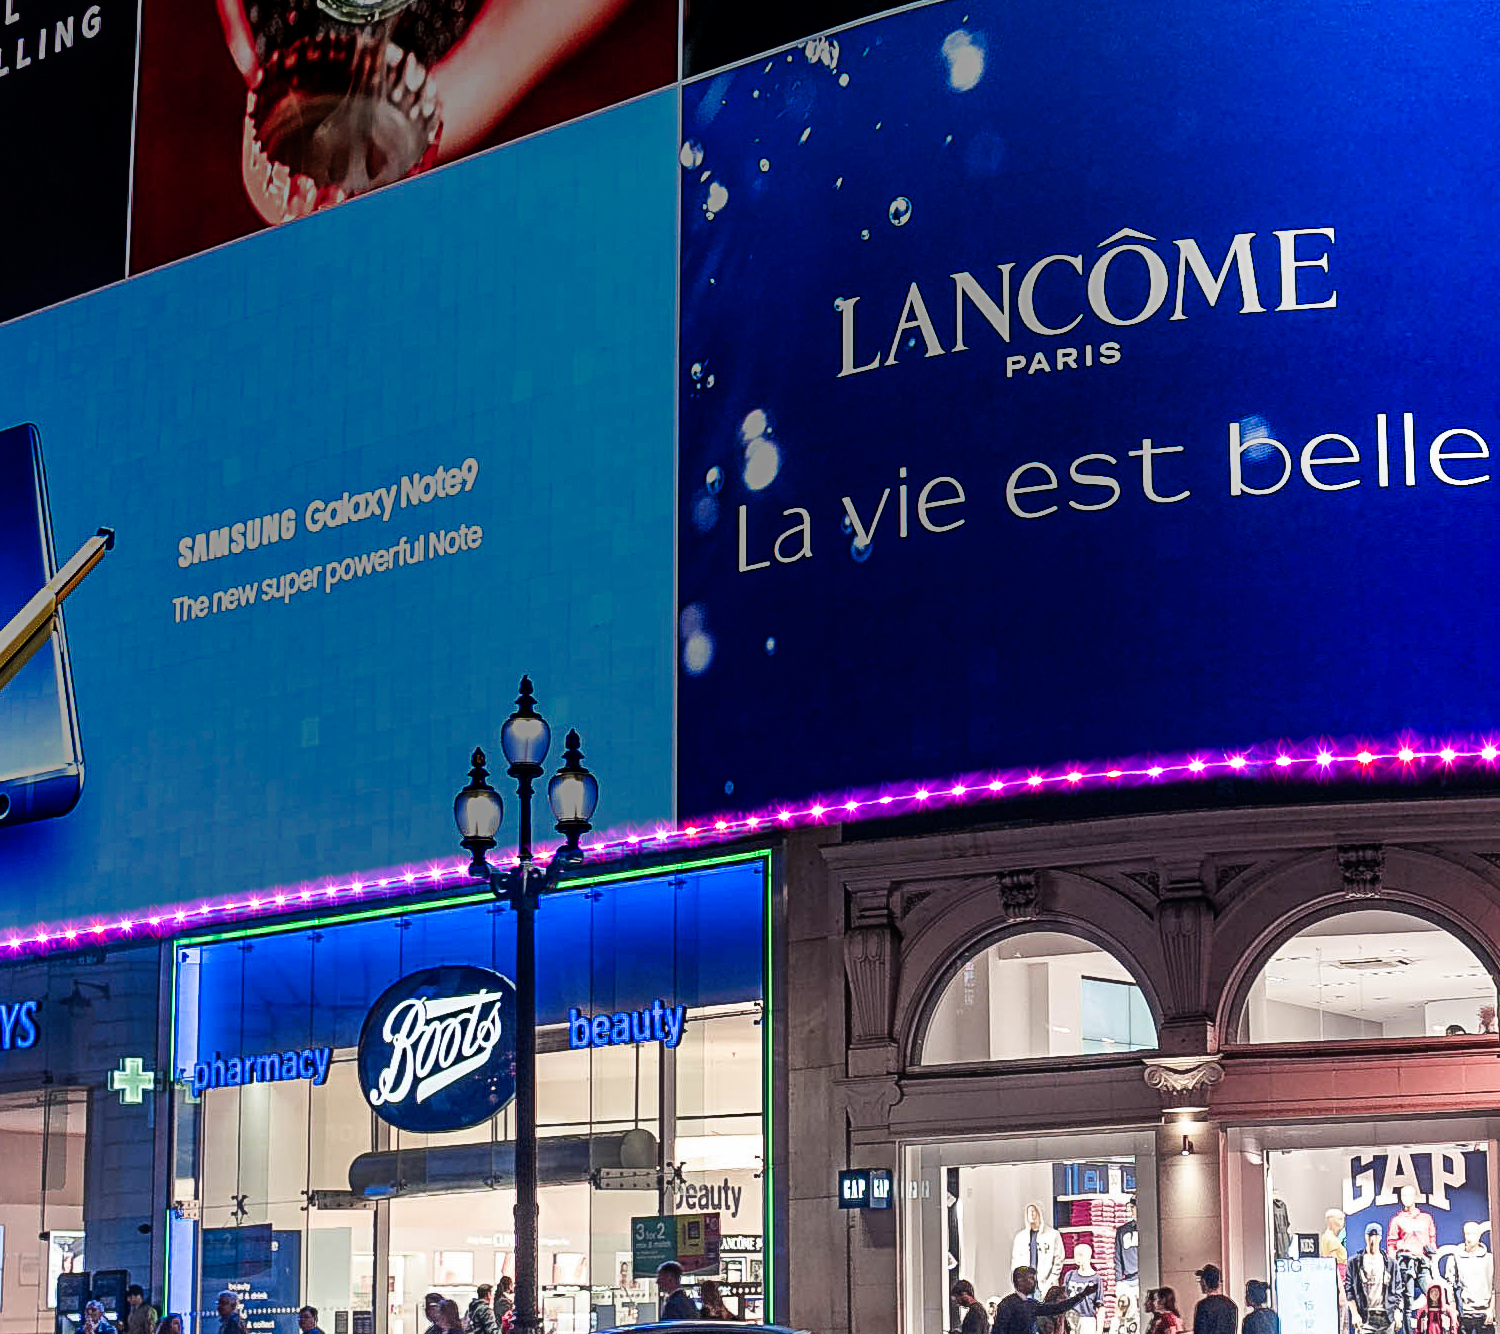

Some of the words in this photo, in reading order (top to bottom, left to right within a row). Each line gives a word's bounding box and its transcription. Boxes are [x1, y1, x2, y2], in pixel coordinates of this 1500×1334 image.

[835, 226, 1338, 378] LANCÔME
[1005, 341, 1122, 379] PARIS
[178, 508, 296, 568] SAMSUNG
[305, 484, 397, 532] Galaxy
[400, 457, 479, 508] Note9
[737, 500, 814, 573] La
[843, 467, 966, 547] vie
[1005, 437, 1191, 519] est
[1228, 411, 1491, 497] belle
[172, 590, 209, 623] The
[212, 580, 258, 613] new
[261, 566, 322, 603] super
[325, 535, 425, 593] powerful
[429, 523, 483, 559] Note
[369, 991, 503, 1104] Boots
[568, 999, 687, 1049] beauty
[191, 1046, 332, 1094] pharmacy
[843, 1179, 866, 1198] GAP
[1342, 1147, 1470, 1215] GAP
